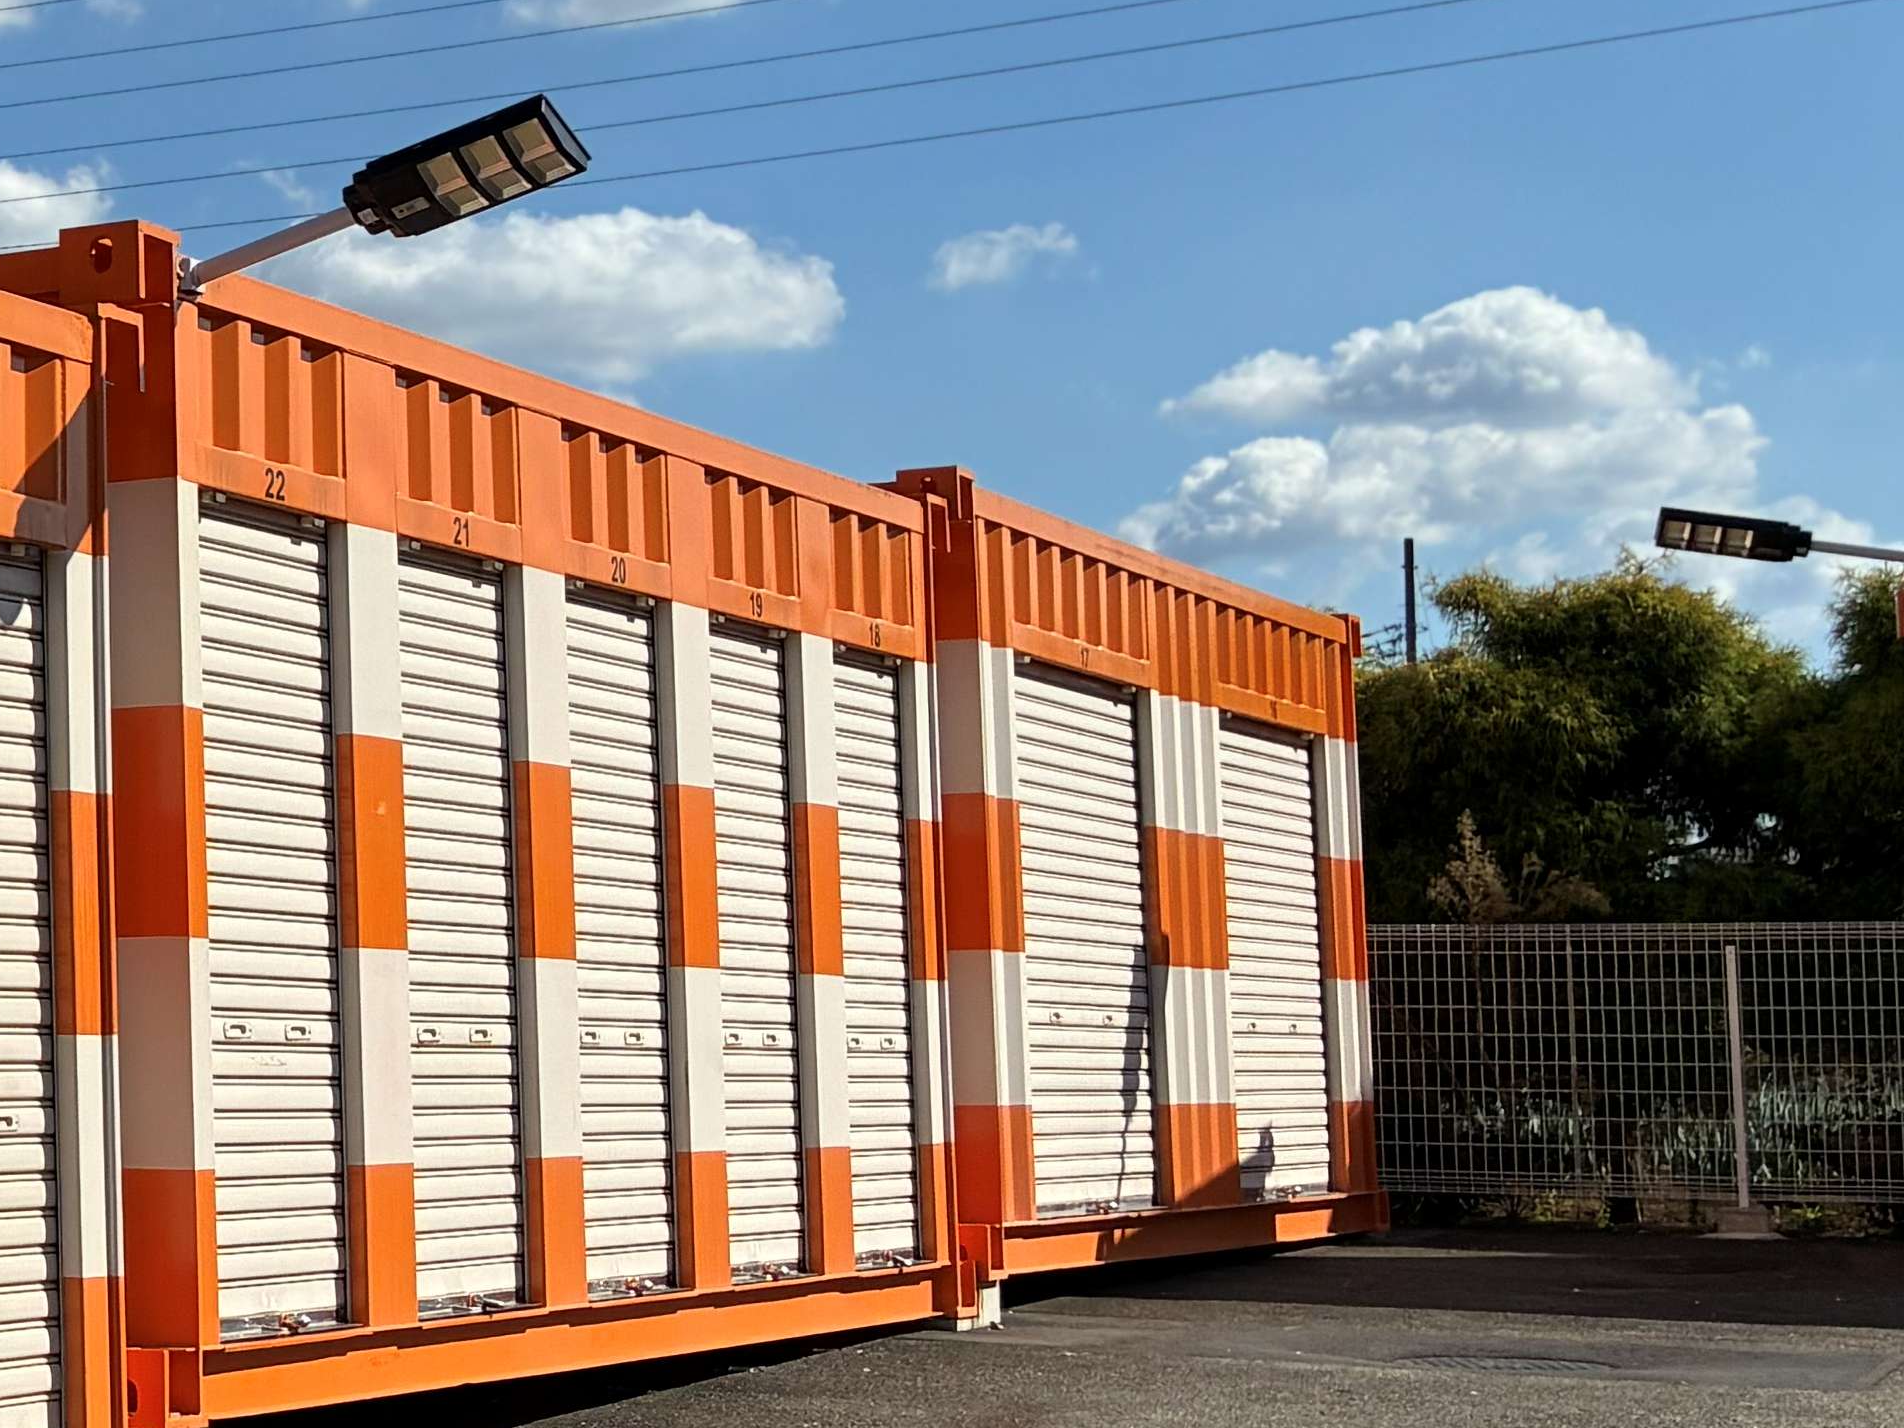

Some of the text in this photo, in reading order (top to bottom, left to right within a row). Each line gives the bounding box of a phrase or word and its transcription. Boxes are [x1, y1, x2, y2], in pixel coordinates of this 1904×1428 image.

[263, 468, 286, 502] 22
[452, 516, 471, 549] 21
[610, 556, 627, 585] 20
[748, 591, 764, 618] 19
[868, 622, 881, 648] 18
